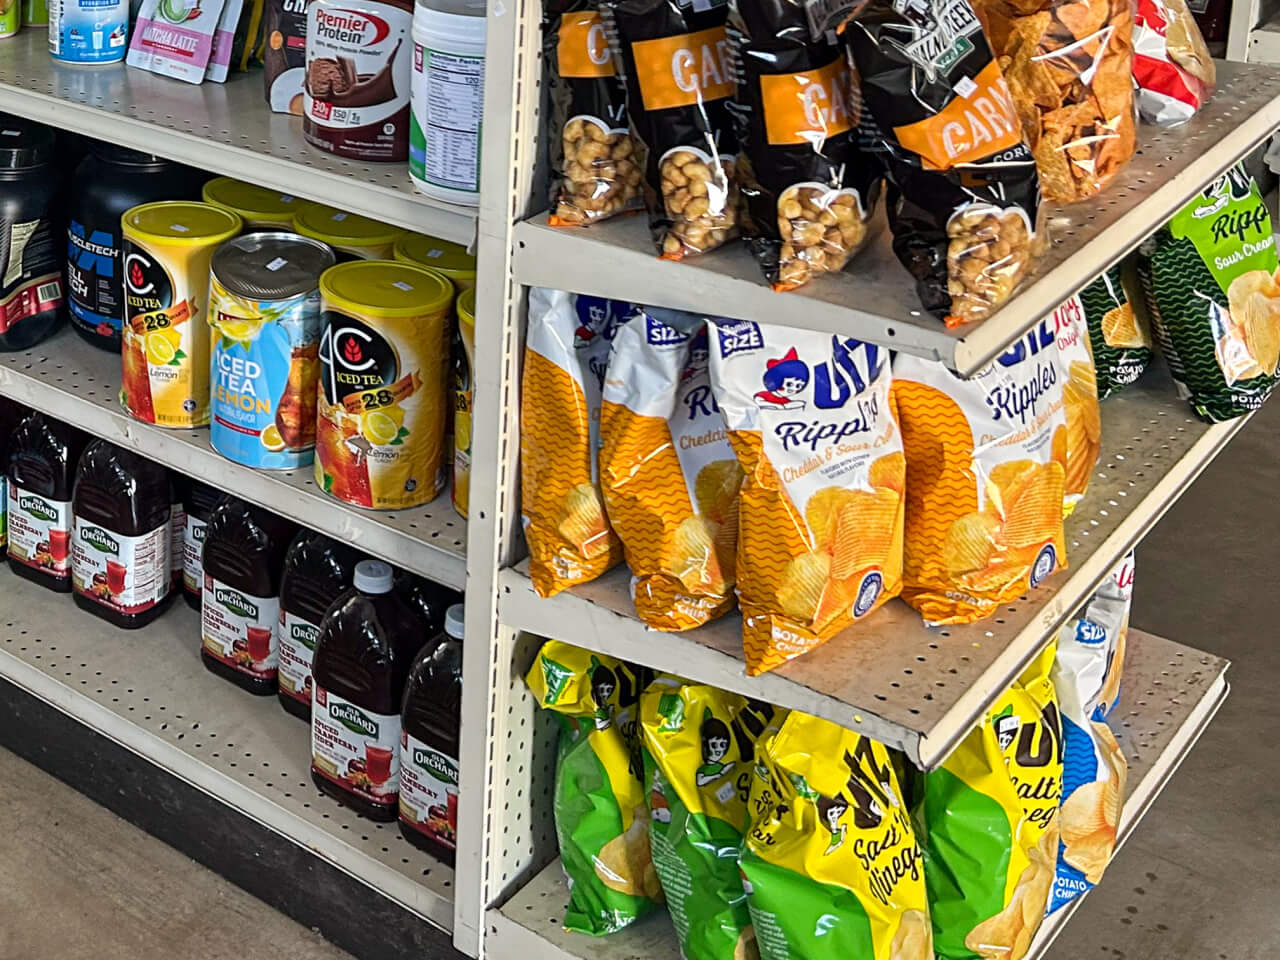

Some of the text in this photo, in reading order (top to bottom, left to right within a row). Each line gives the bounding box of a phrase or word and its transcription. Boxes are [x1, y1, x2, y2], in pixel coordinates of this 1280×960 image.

[316, 9, 369, 32] Premier
[317, 23, 362, 44] Protein
[333, 109, 347, 118] 150
[1214, 253, 1244, 270] Sour
[145, 297, 162, 309] TEA
[143, 313, 168, 330] 28
[723, 331, 762, 353] SIZE
[148, 368, 178, 380] Lemon
[217, 350, 261, 378] ICED
[812, 334, 884, 409] UTZ
[220, 375, 256, 396] TEA
[336, 372, 385, 386] ICED TEA
[362, 390, 393, 410] 28
[986, 359, 1056, 425] Ripples
[367, 449, 399, 459] Lemon
[21, 499, 56, 519] ORCHARD
[82, 529, 118, 552] ORCHARD
[217, 589, 256, 616] ORCHARD
[331, 704, 377, 734] ORCHARD
[346, 706, 361, 715] OLD
[315, 726, 358, 753] CRANBERRY
